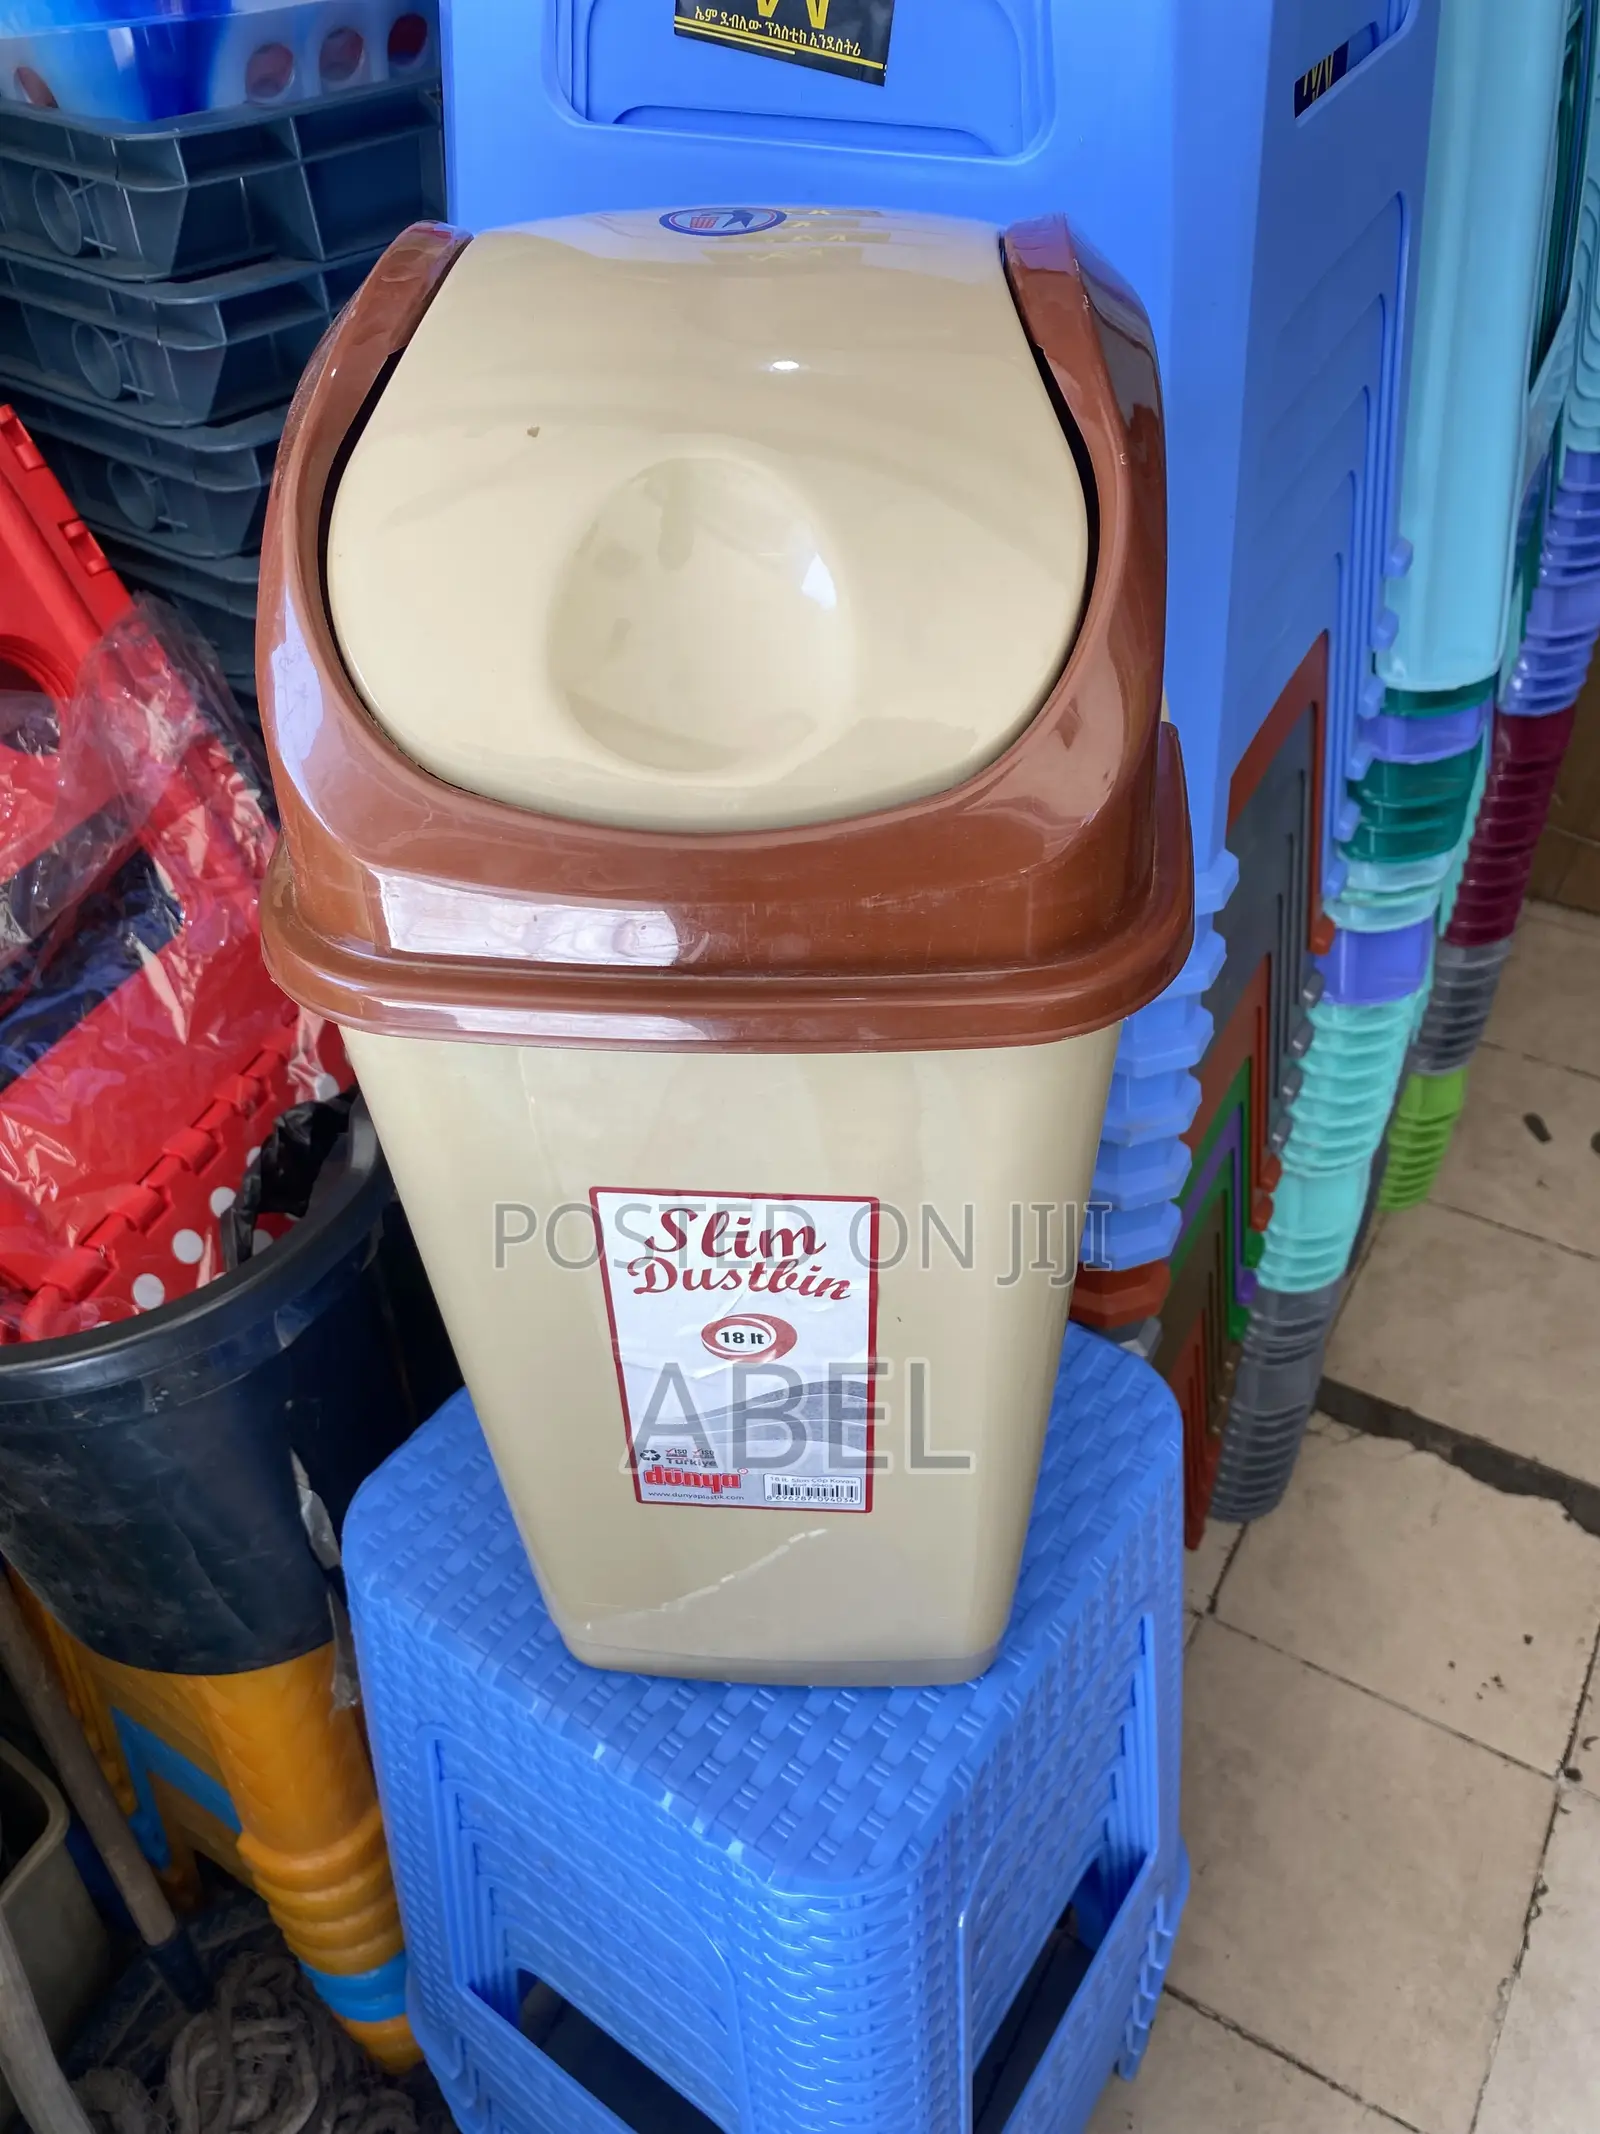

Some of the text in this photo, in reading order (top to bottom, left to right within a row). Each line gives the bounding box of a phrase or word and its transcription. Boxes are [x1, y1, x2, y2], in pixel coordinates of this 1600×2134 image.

[643, 1207, 827, 1260] Slim
[626, 1256, 851, 1301] Dustbin
[720, 1330, 765, 1346] 18 lt
[644, 1464, 742, 1494] dünya
[648, 1491, 745, 1500] www.dunyaplastik.com
